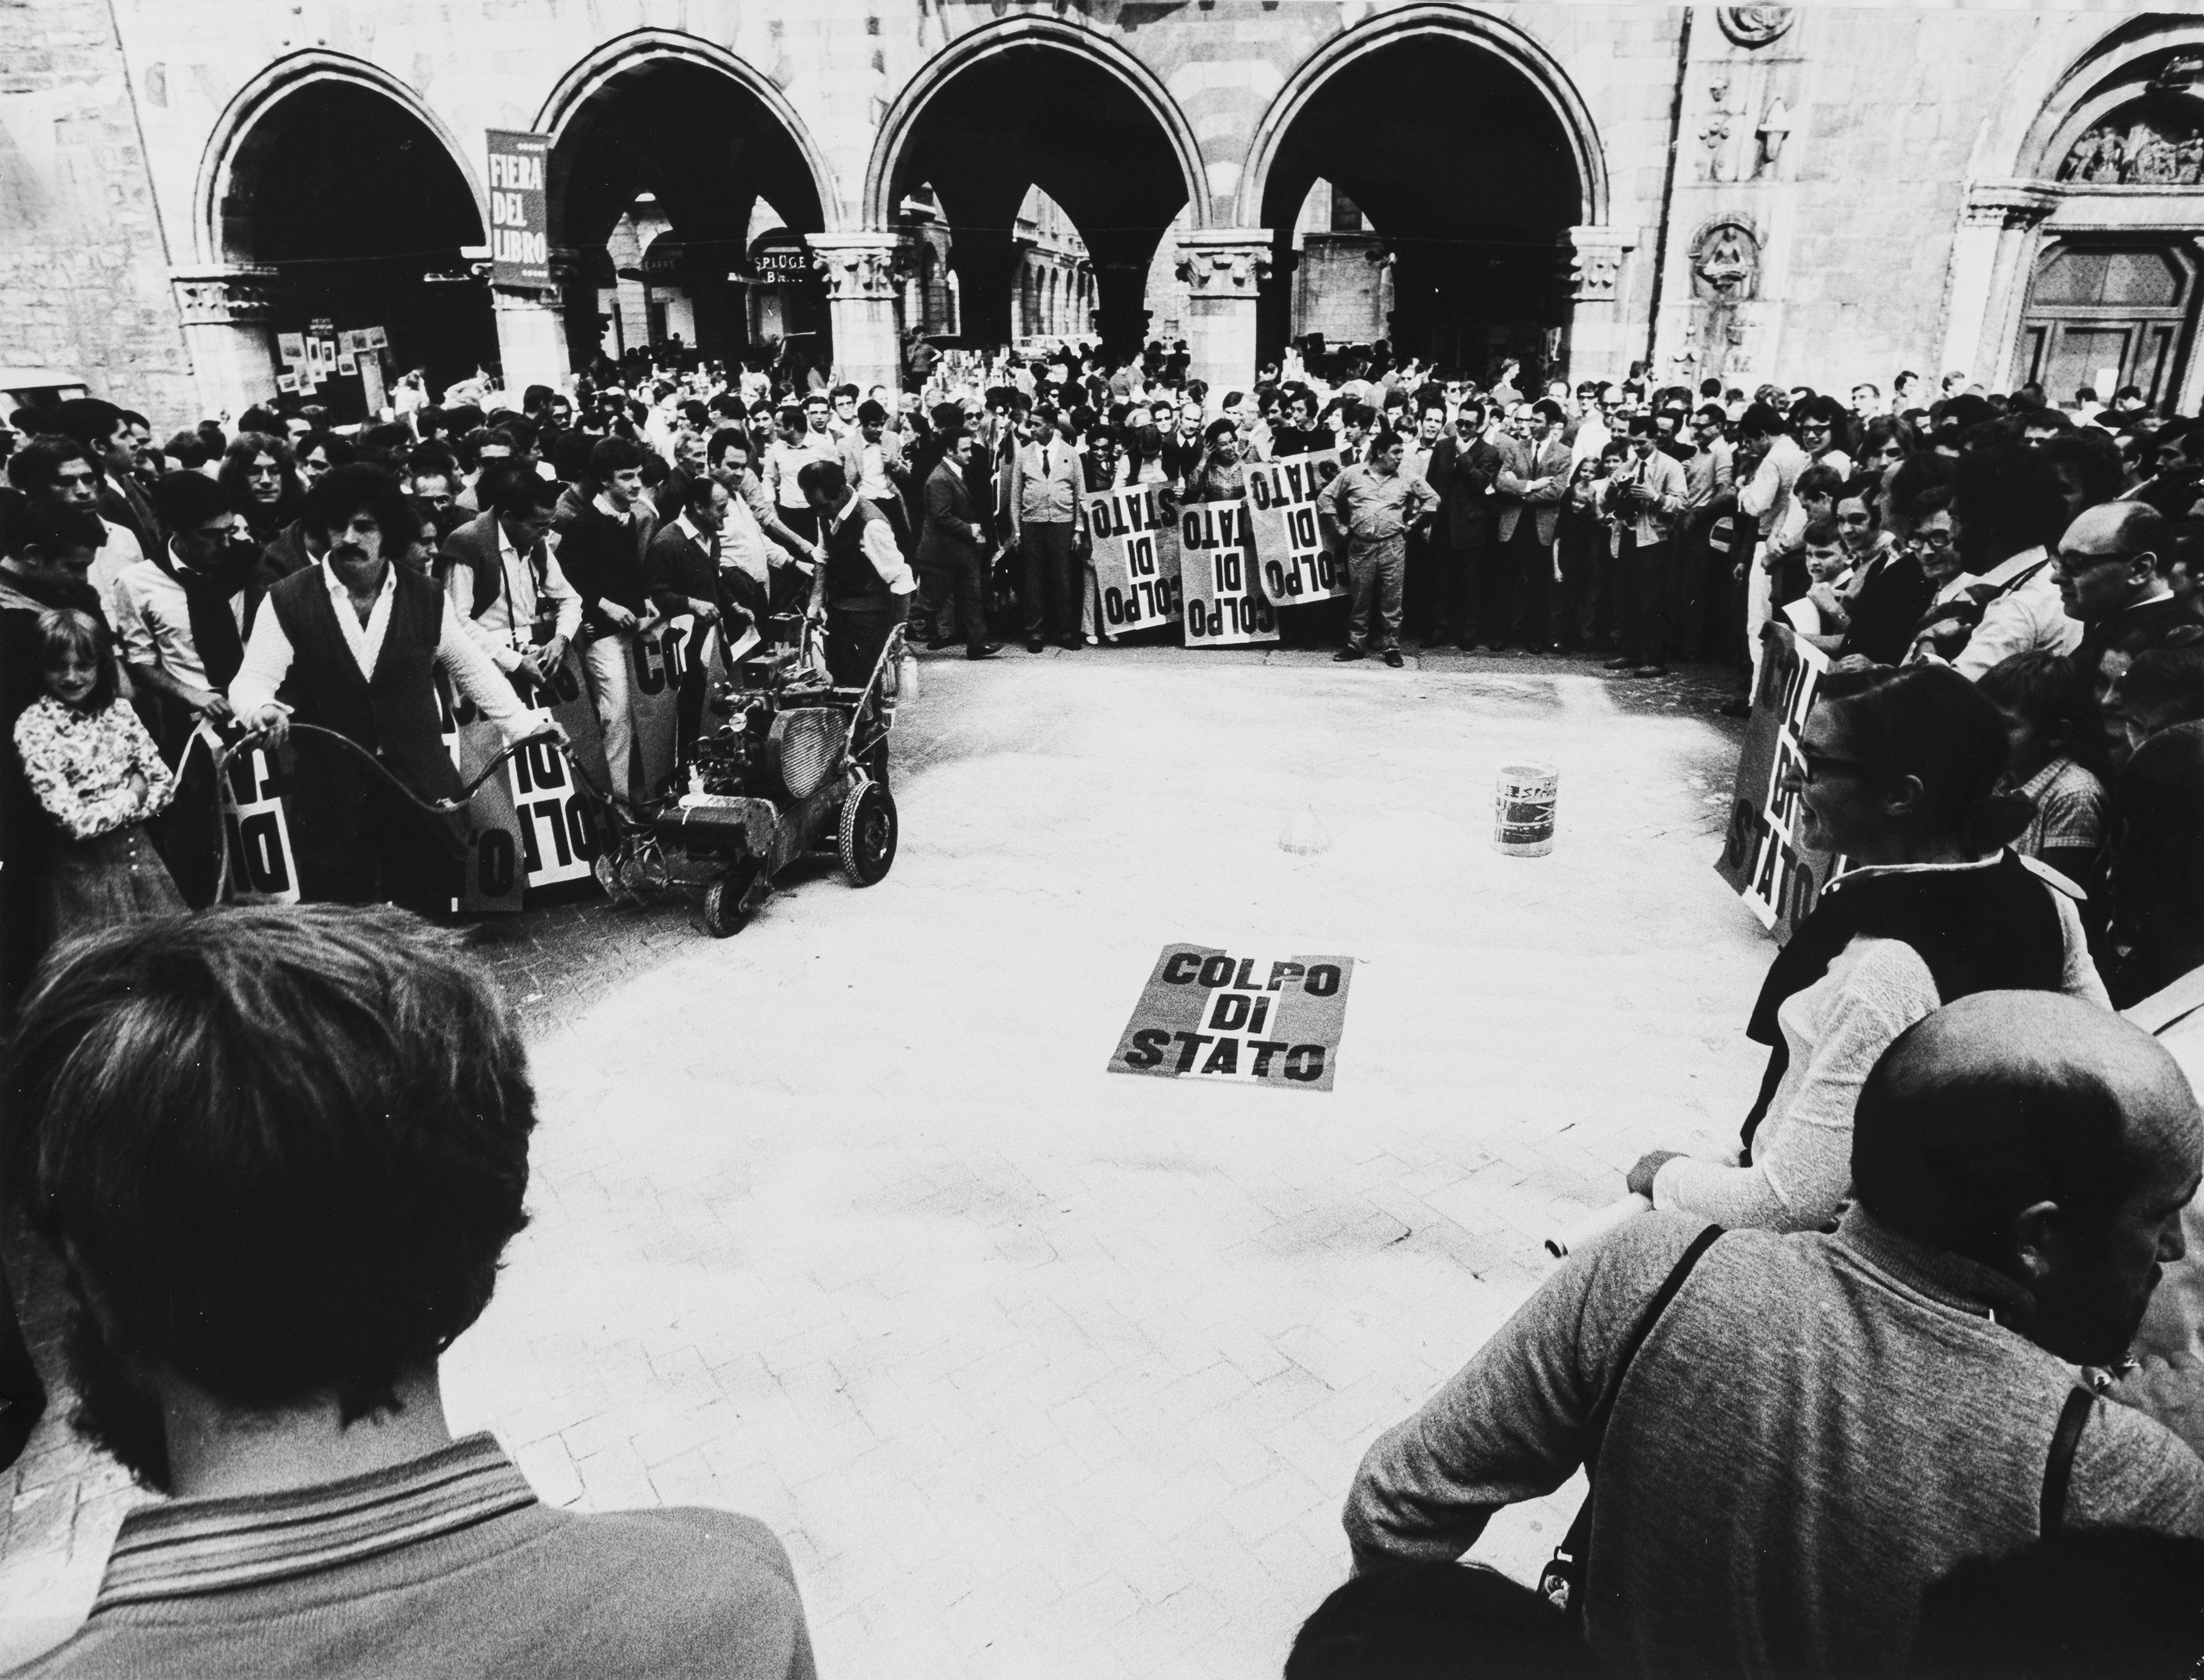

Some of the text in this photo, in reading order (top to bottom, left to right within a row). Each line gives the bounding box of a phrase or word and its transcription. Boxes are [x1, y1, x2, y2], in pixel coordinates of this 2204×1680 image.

[489, 153, 543, 190] FIERA
[492, 191, 528, 227] DEL
[494, 229, 547, 264] LIBRO
[1091, 488, 1179, 539] STATO
[1183, 506, 1256, 550] TATO
[1287, 508, 1317, 550] DI
[1127, 536, 1156, 577] DI
[1215, 553, 1242, 592] DI
[1188, 596, 1275, 637] COLPO
[1162, 953, 1341, 997] COLPO
[1208, 994, 1271, 1034] DI
[1125, 1028, 1326, 1082] STATO
